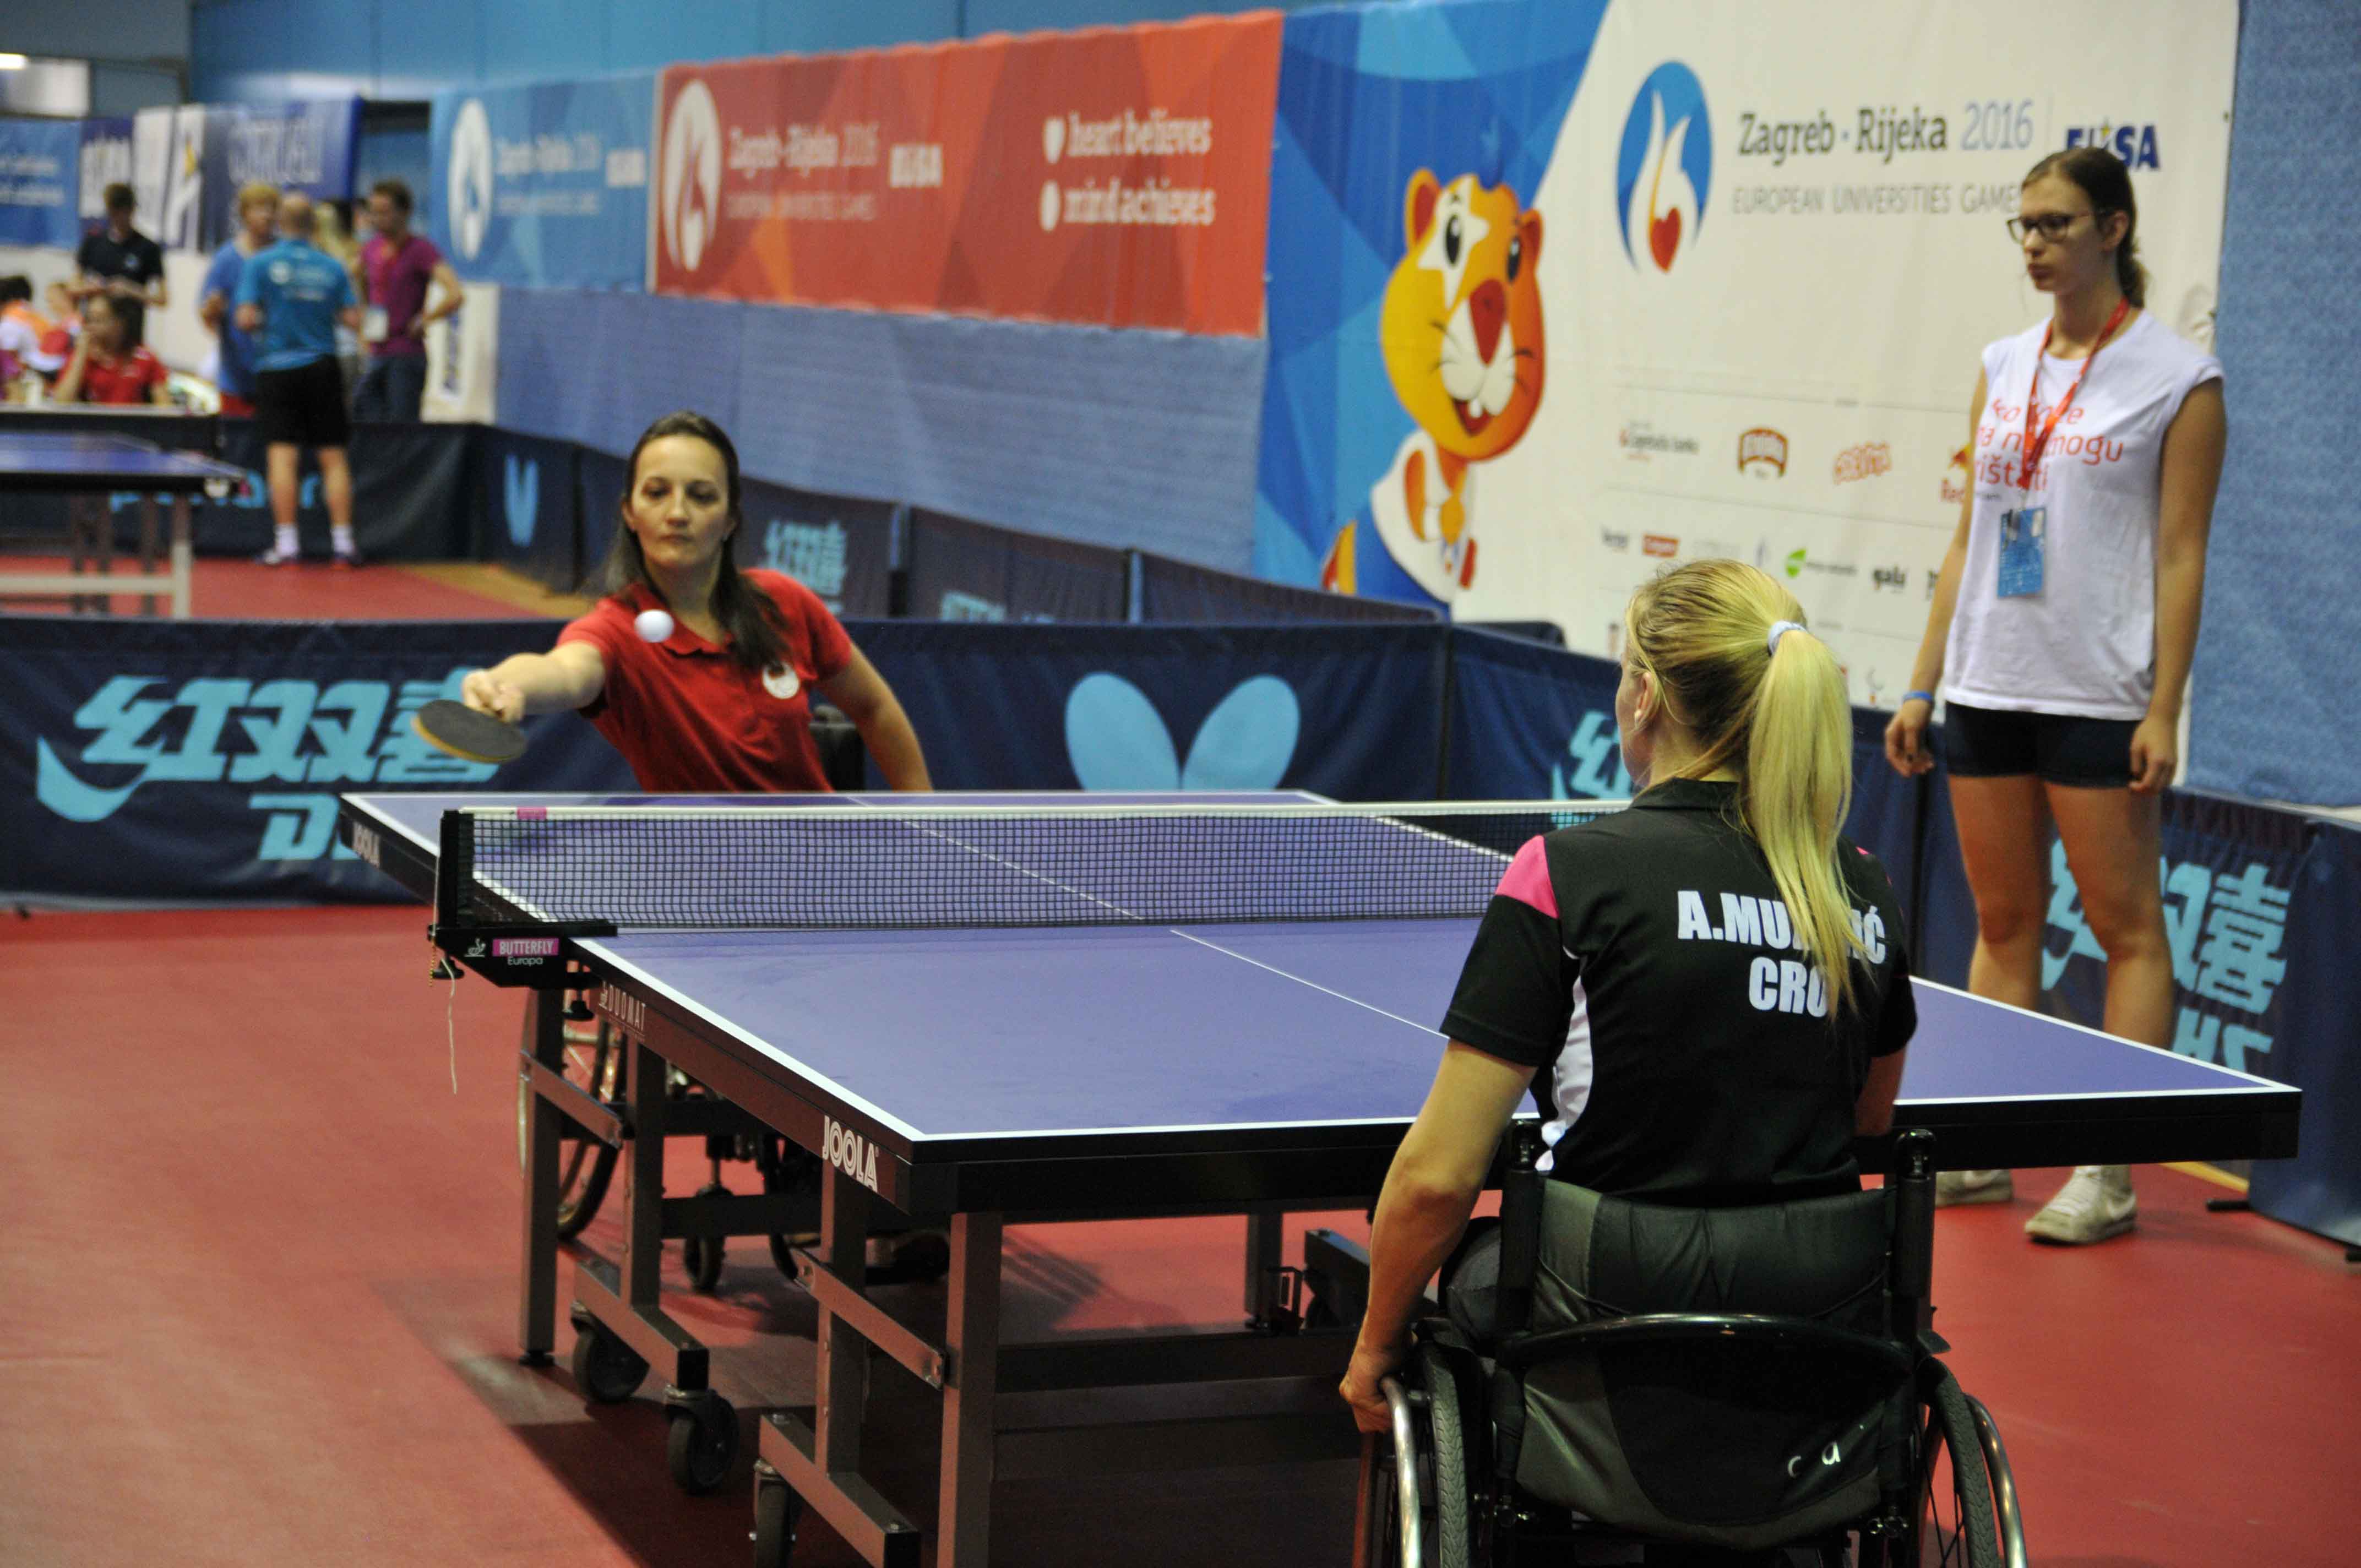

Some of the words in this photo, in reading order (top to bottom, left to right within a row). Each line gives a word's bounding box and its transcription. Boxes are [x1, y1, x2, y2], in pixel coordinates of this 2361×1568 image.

[1067, 110, 1122, 156] heart
[1124, 107, 1212, 156] believes
[1738, 110, 1835, 166] Zagreb
[1855, 105, 1947, 165] Rijeka
[1961, 101, 2034, 151] 2016
[2068, 125, 2161, 168] ESA
[1732, 184, 1825, 215] EUROPEAN
[1832, 183, 1952, 215] UNIVERSITIES
[1960, 182, 2022, 214] GAME
[499, 938, 554, 956] BUTTERFLY
[1678, 890, 1886, 965] A.MUIĆ
[508, 957, 543, 966] Europa
[1749, 957, 1829, 1017] CRO
[822, 1115, 878, 1193] JOOLA
